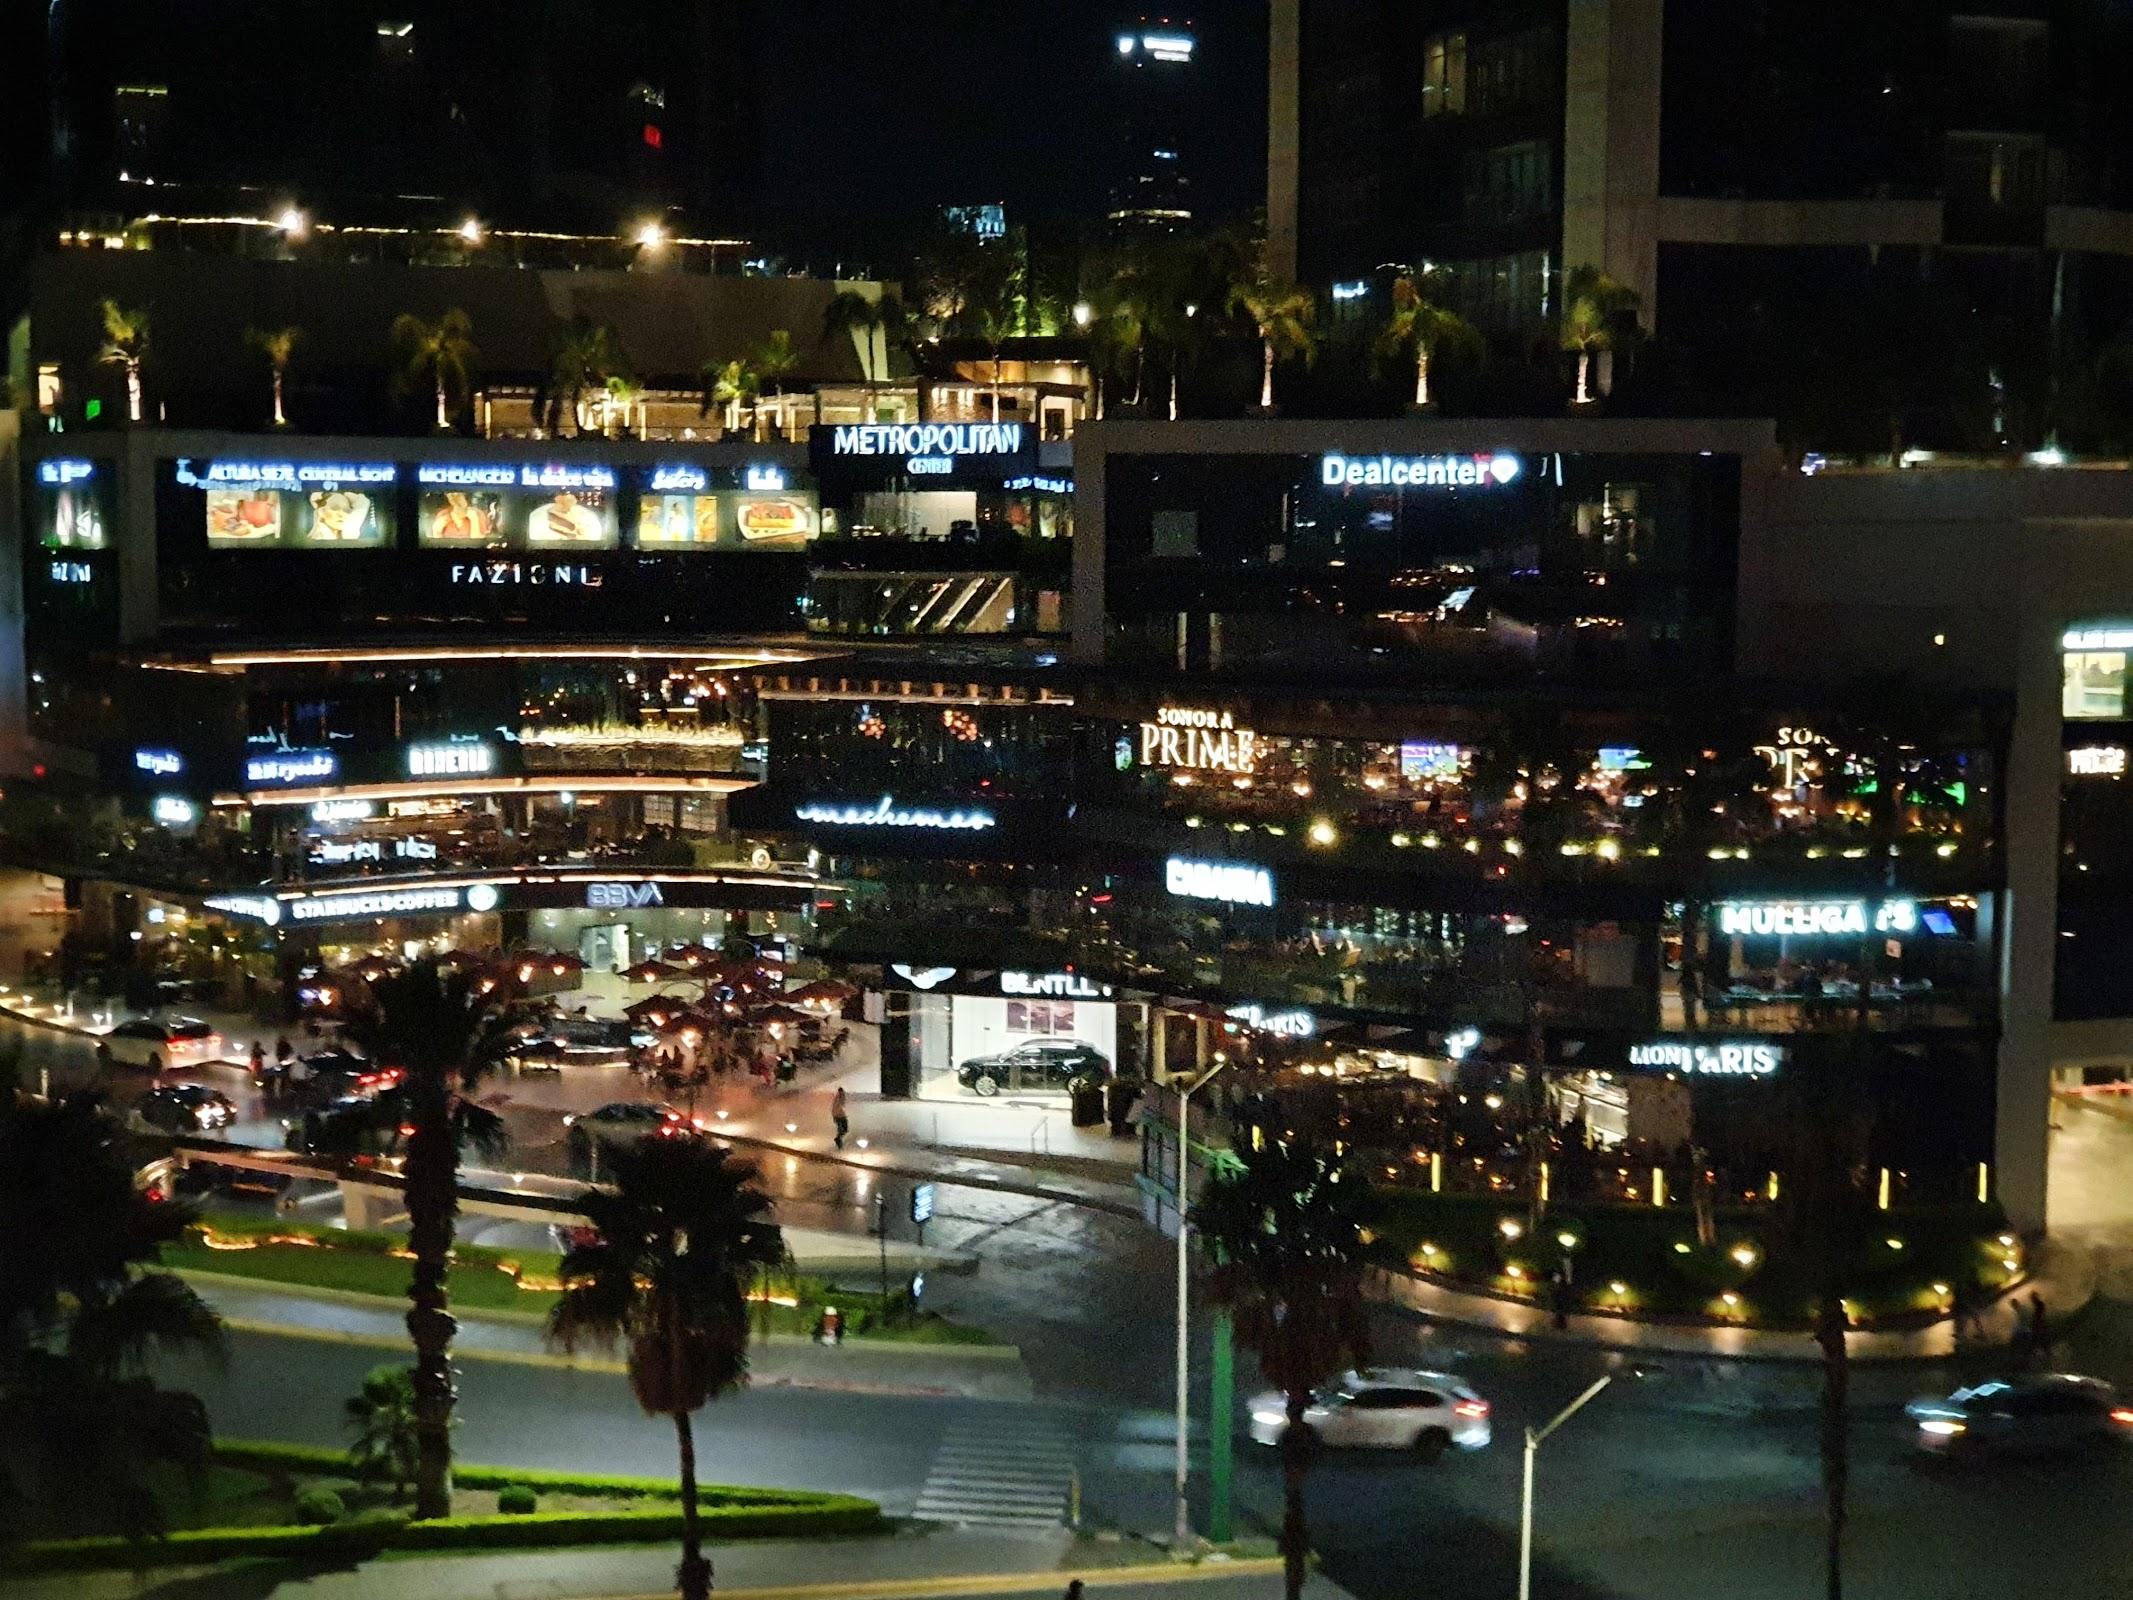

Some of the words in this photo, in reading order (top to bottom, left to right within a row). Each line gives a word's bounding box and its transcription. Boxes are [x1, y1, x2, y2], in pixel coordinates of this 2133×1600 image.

[834, 424, 1020, 454] METROPOLITAN
[1322, 455, 1490, 485] Dealcenter
[1157, 707, 1234, 730] SONORA
[1139, 722, 1255, 774] PRIME
[587, 881, 664, 908] BBVA
[1001, 971, 1112, 997] BENTLE
